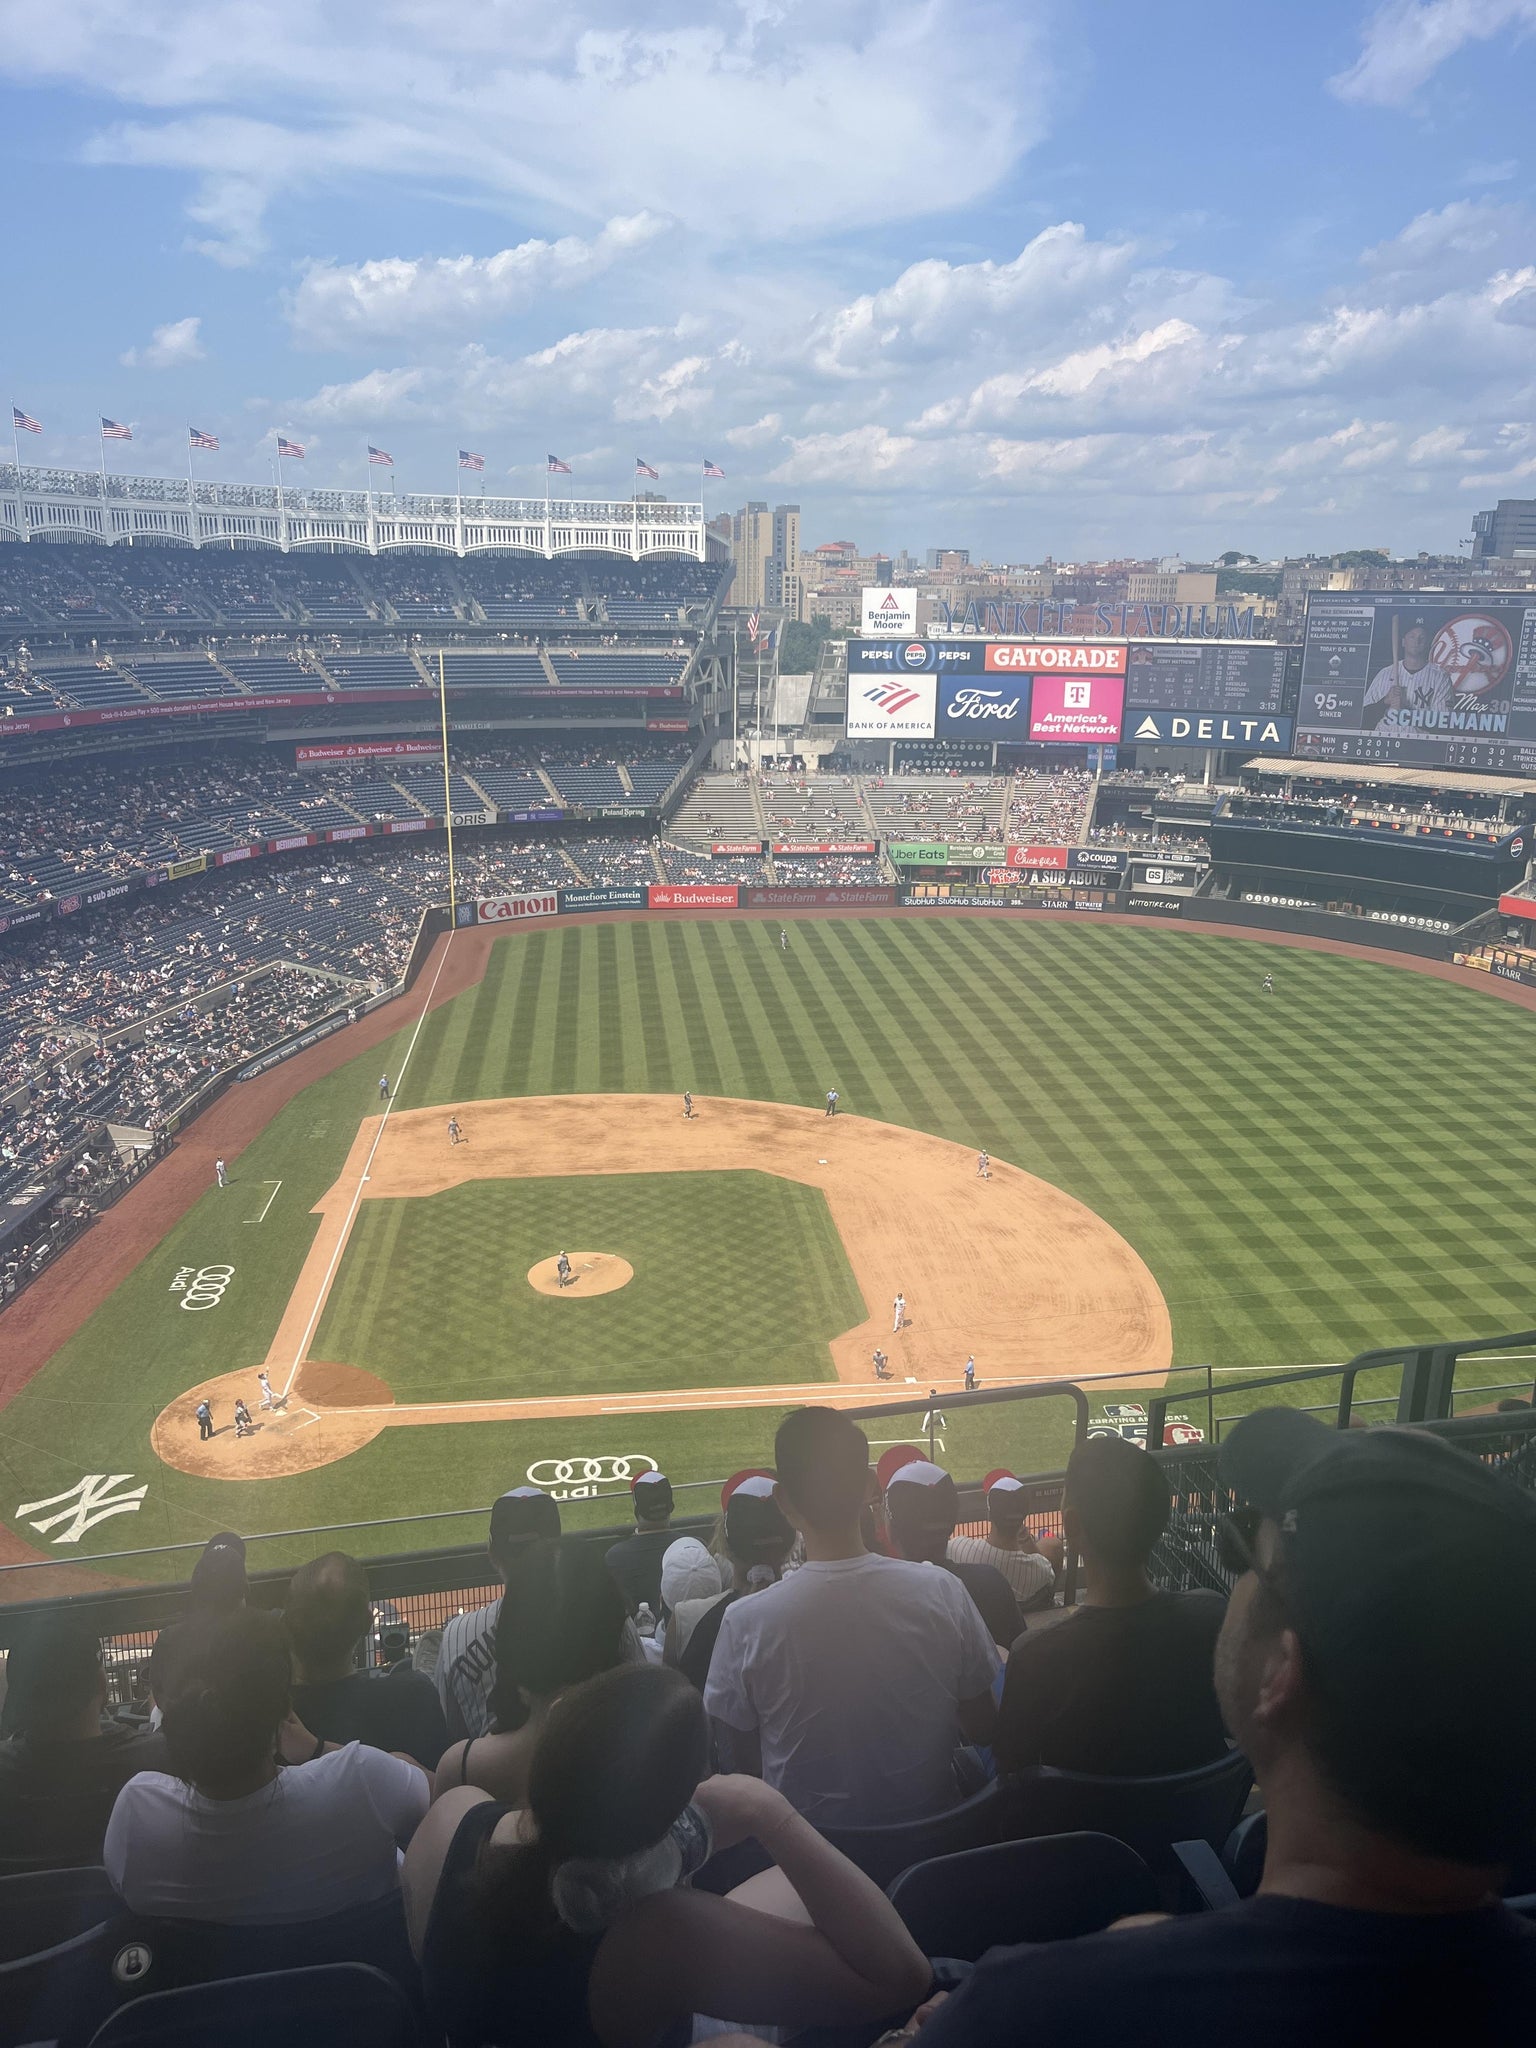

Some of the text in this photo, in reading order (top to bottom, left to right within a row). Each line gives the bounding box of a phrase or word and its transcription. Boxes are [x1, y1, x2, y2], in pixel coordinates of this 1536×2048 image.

[868, 611, 911, 622] Benjamin
[941, 600, 1256, 639] YANKEE STADIUM
[873, 621, 902, 629] Moore
[862, 650, 892, 660] PEPSI
[938, 651, 970, 660] PEPSI
[994, 648, 1120, 668] GATORADE
[1070, 685, 1084, 704] T
[174, 704, 192, 712] donated
[197, 702, 218, 710] Covenant
[947, 688, 1020, 720] Ford
[1260, 702, 1276, 711] 3:13
[1314, 693, 1337, 710] 95
[1453, 693, 1488, 713] Max
[1490, 700, 1509, 714] 30
[1043, 712, 1108, 724] America's
[1320, 710, 1342, 718] SINKER
[1384, 708, 1508, 732] SCHUEMANN
[14, 722, 30, 730] Jersey
[1032, 722, 1118, 735] Best Network
[1172, 718, 1280, 742] DELTA
[1322, 736, 1336, 744] MIN
[1342, 742, 1348, 750] 5
[309, 743, 442, 757] Budweiser Budweiser Budweiser
[1321, 746, 1335, 754] NYY
[1488, 758, 1493, 766] 3
[454, 808, 645, 826] ORIS Poland Spring
[392, 820, 426, 832] BENIHANA
[332, 828, 366, 840] BENIHANA
[276, 836, 308, 850] BENIHANA
[222, 848, 251, 862] BENIHANA
[919, 850, 945, 860] Eats
[1014, 848, 1059, 866] Chick-fil-A
[1090, 854, 1117, 864] coupa
[1030, 870, 1038, 883] A
[1043, 871, 1065, 884] SUB
[1068, 871, 1107, 886] ABOVE
[1149, 871, 1160, 879] GS
[87, 884, 129, 903] a sub above
[565, 891, 640, 902] Montefiore Einstein
[479, 896, 555, 920] Canon
[904, 898, 1004, 907] StubHub StubHub StubHub
[1042, 900, 1068, 909] STARR
[1129, 898, 1180, 910] NITTOTIRE.COM
[15, 916, 25, 924] sub
[25, 911, 41, 922] above
[1496, 965, 1521, 981] STARR
[168, 1266, 196, 1291] Audi
[550, 1485, 598, 1500] udi
[14, 1474, 148, 1544] NY
